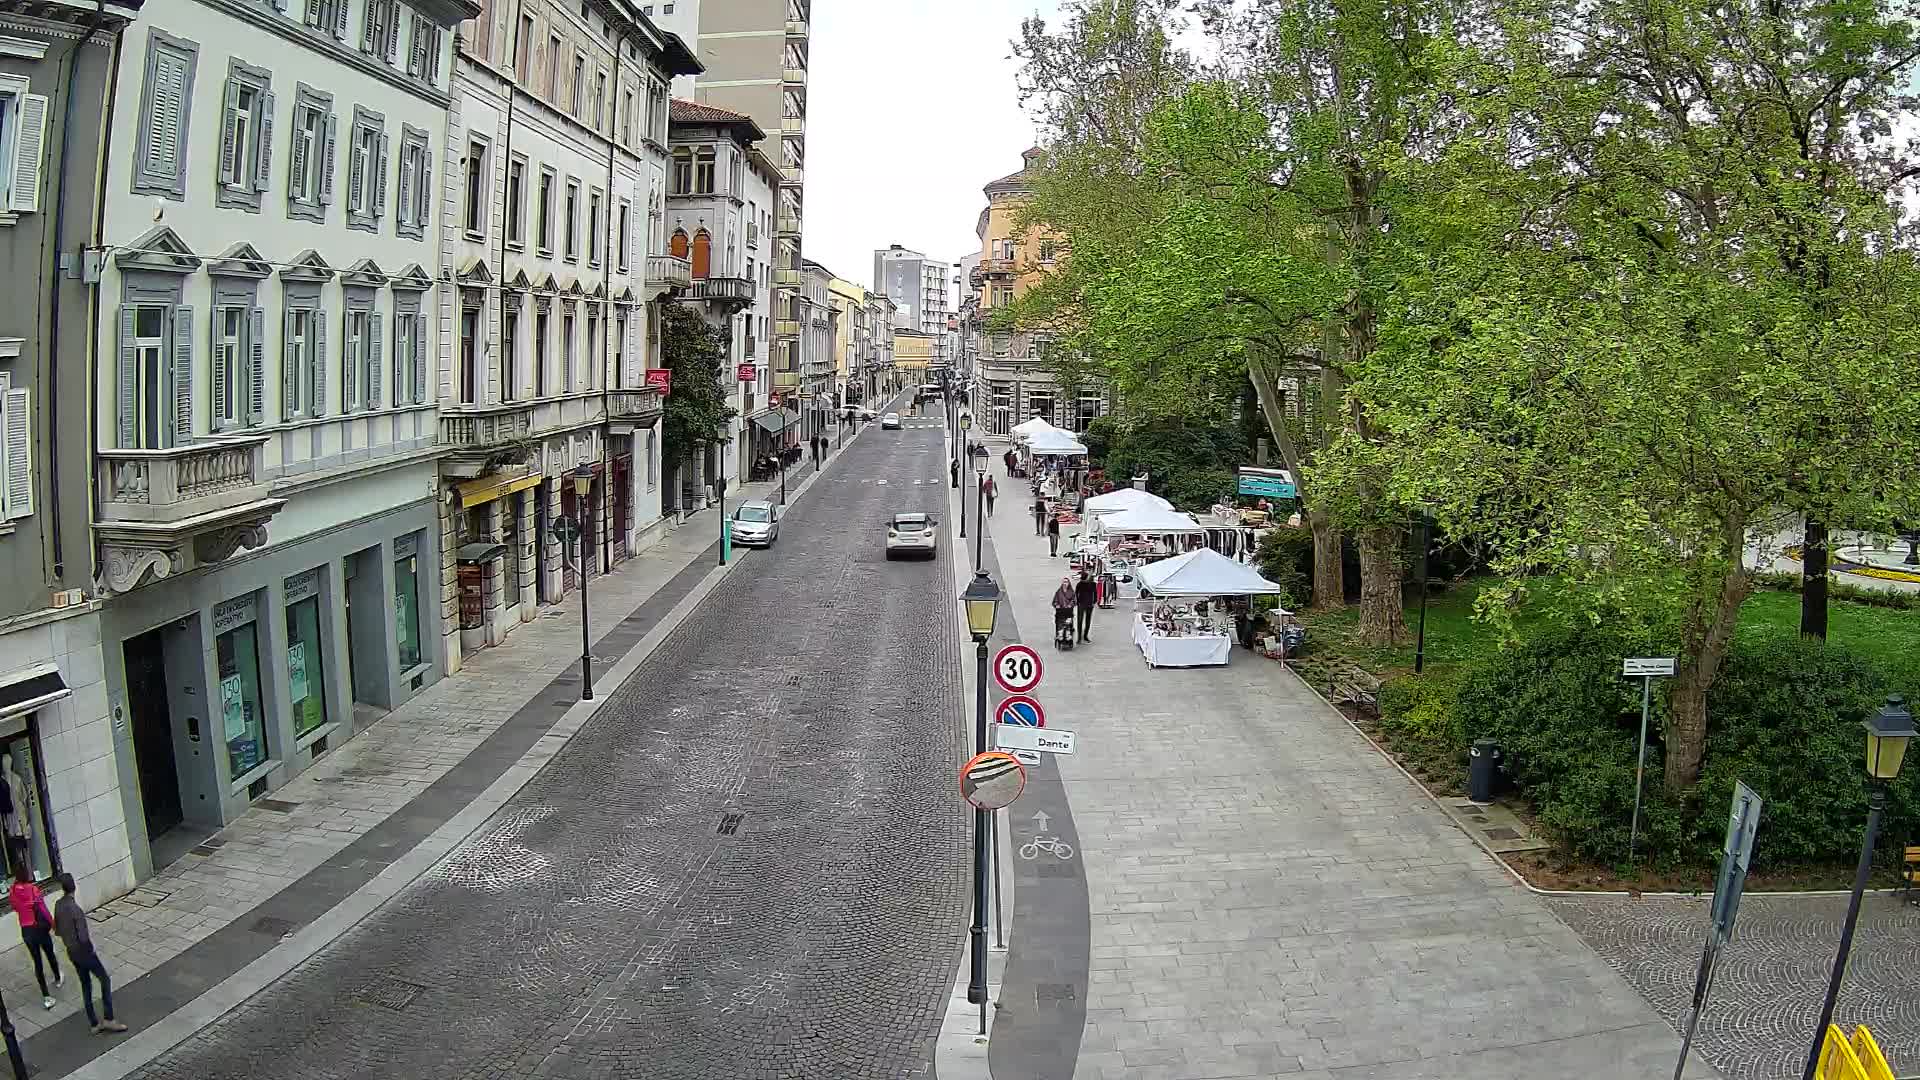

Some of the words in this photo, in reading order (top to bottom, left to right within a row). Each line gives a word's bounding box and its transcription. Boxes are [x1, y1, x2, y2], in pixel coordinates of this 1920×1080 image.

[286, 645, 304, 667] 130
[1005, 657, 1033, 681] 30
[222, 677, 240, 700] 130
[1038, 737, 1069, 749] Dante
